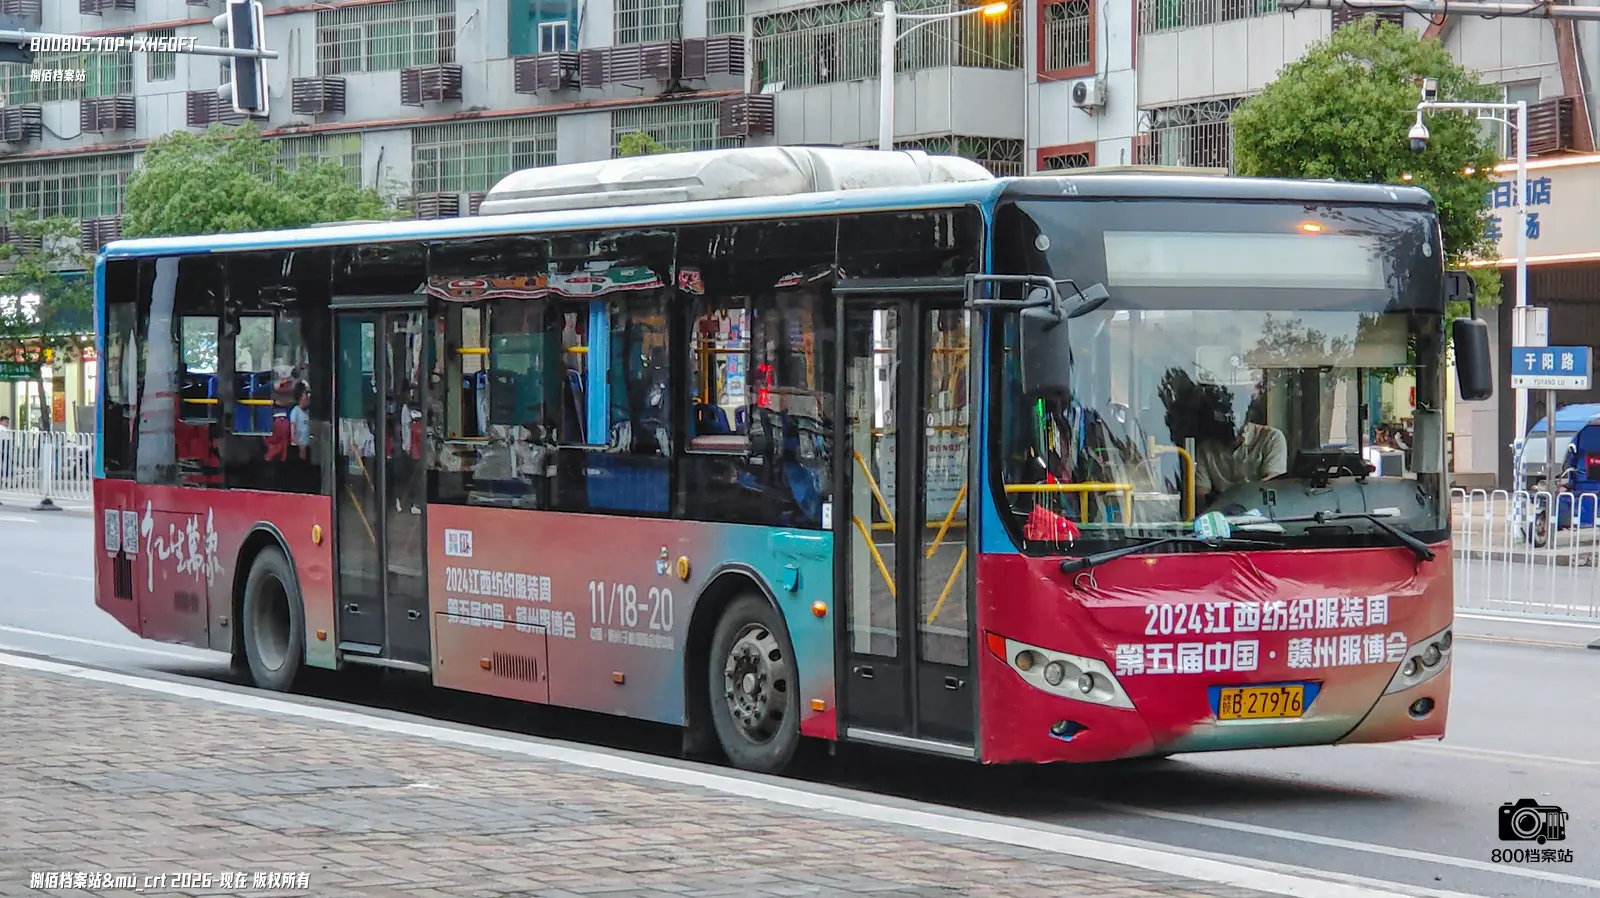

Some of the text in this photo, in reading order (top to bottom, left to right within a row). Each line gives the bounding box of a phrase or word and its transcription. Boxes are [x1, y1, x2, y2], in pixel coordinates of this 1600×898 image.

[1524, 352, 1574, 371] 于阳路
[445, 566, 552, 603] 2024江西纺织服装周
[589, 580, 674, 632] 11/18-20
[1145, 595, 1388, 636] 2024江西纺织服装周
